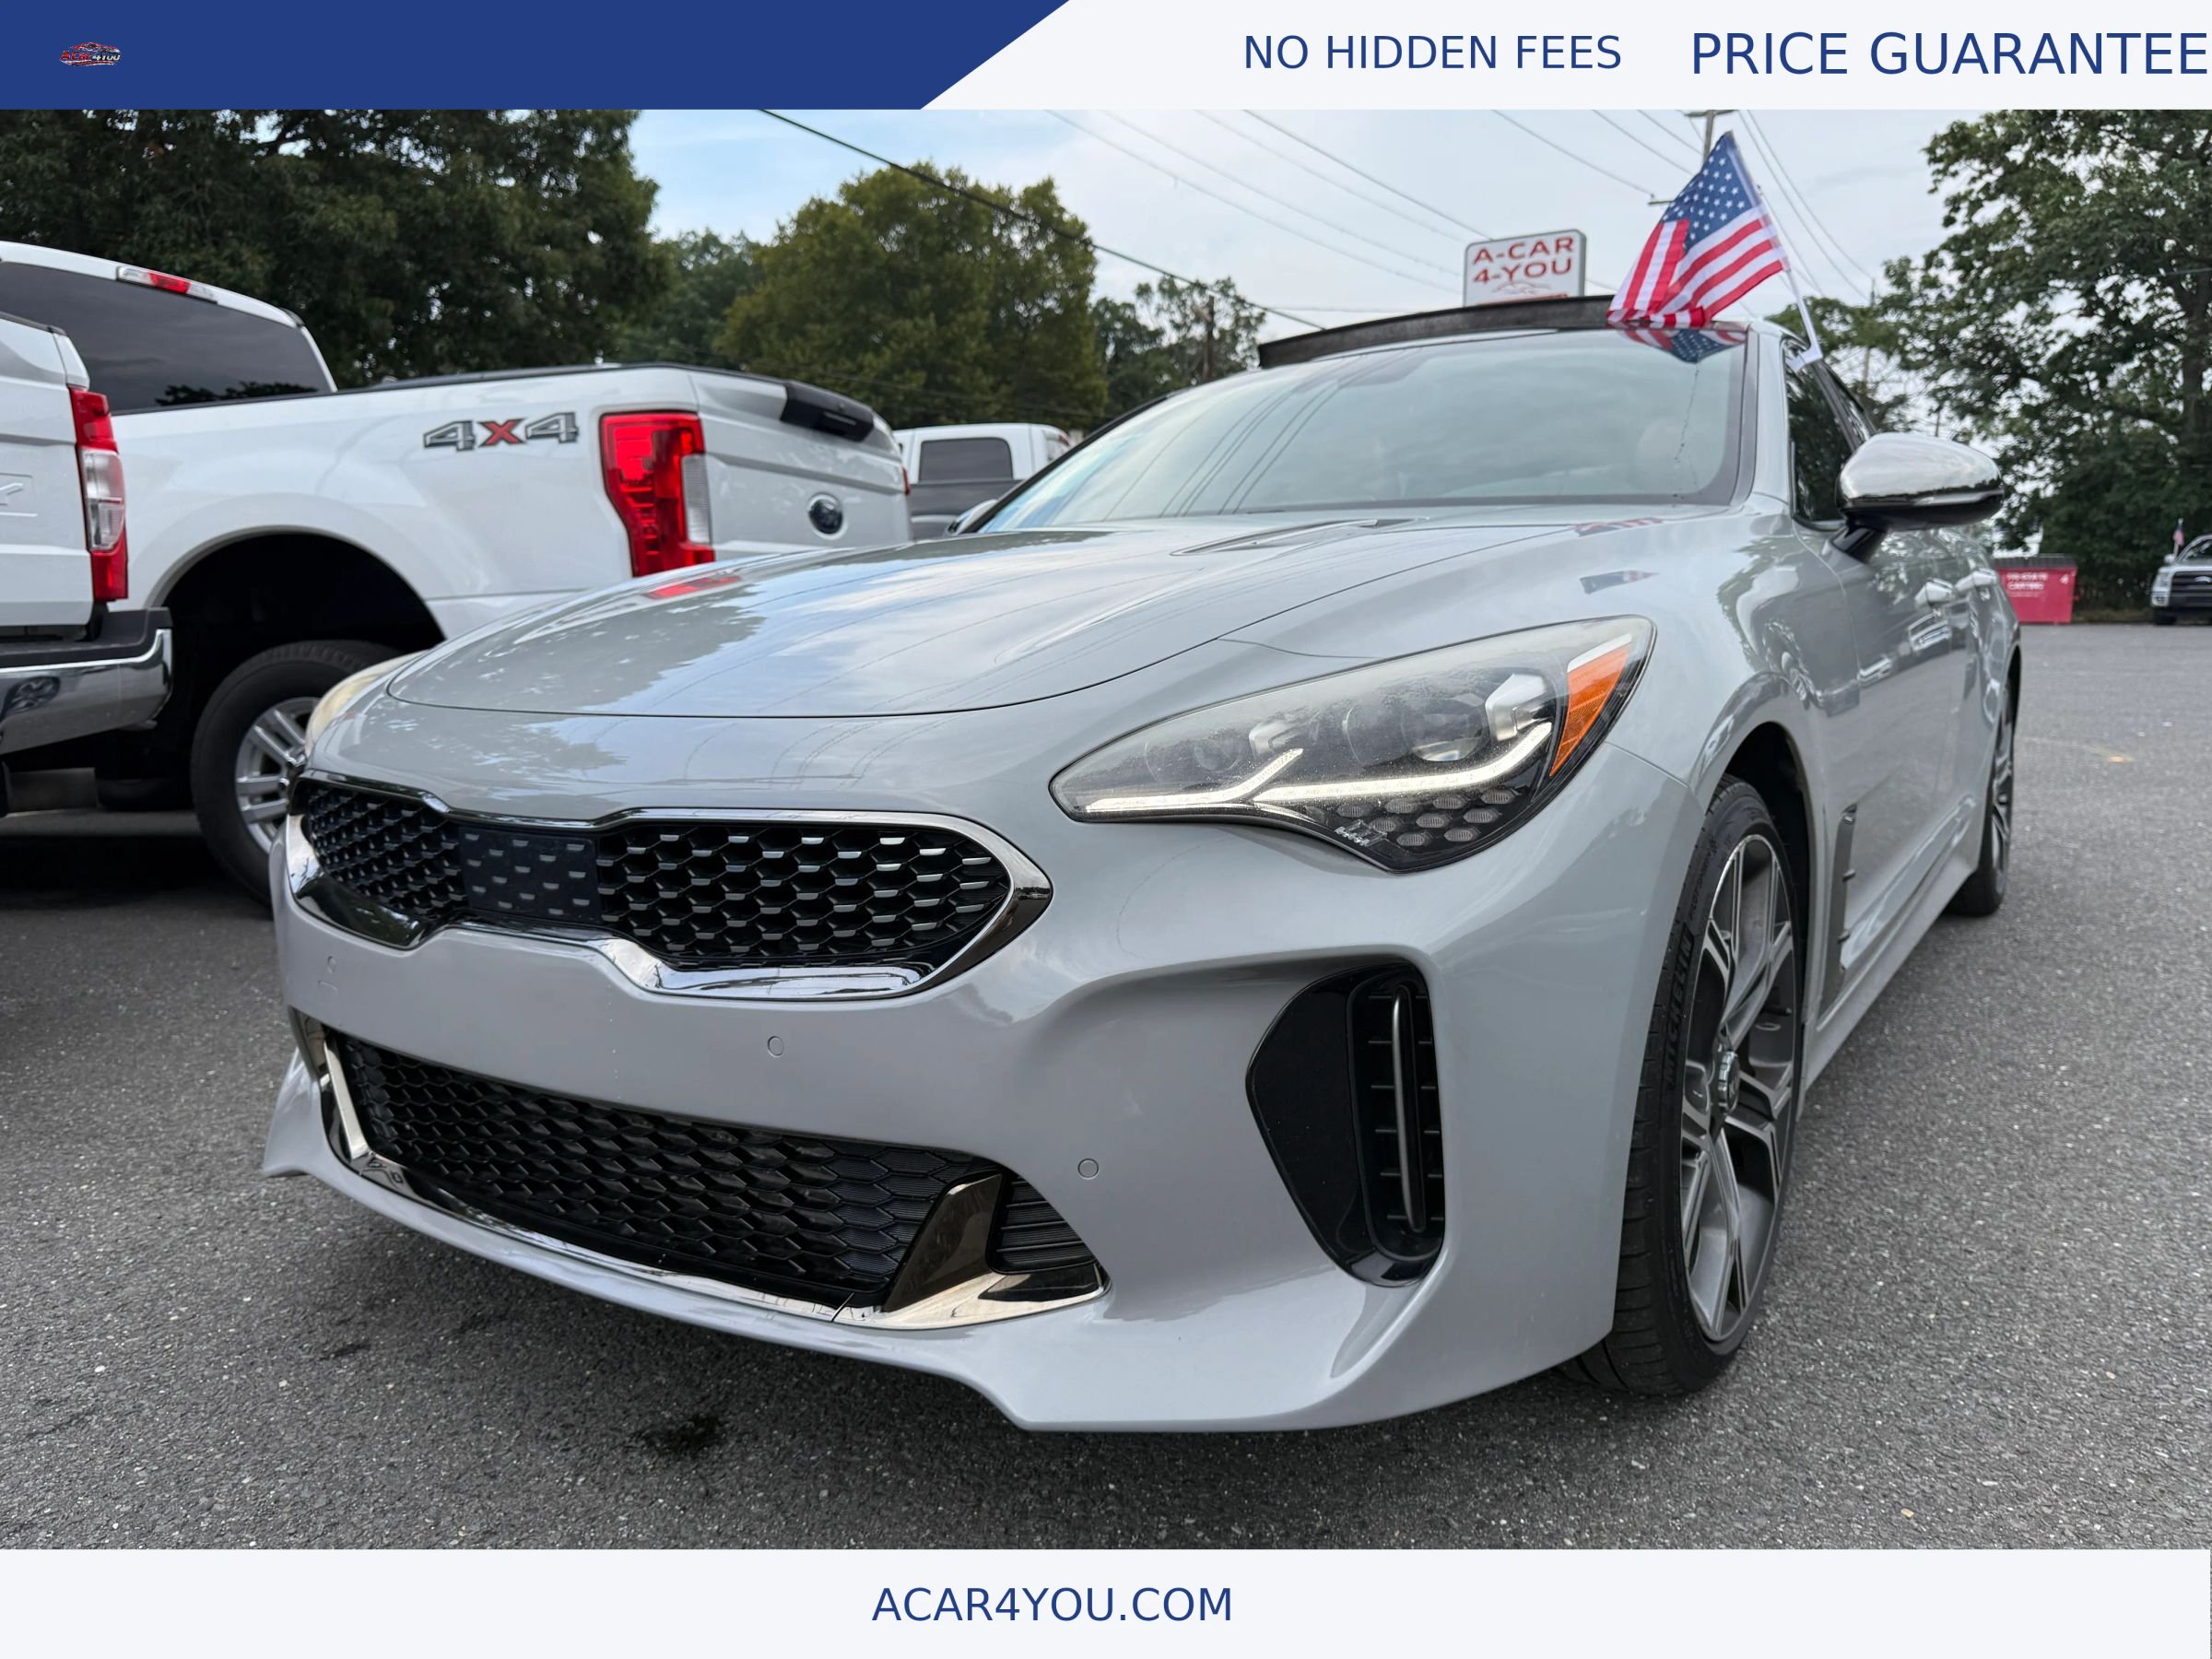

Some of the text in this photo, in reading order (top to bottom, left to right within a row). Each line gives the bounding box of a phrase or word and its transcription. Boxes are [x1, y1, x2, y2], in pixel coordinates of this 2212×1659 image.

[1473, 236, 1574, 265] A-CAR
[1474, 257, 1572, 285] 4-YOU
[1663, 931, 1695, 1091] MICHELIN
